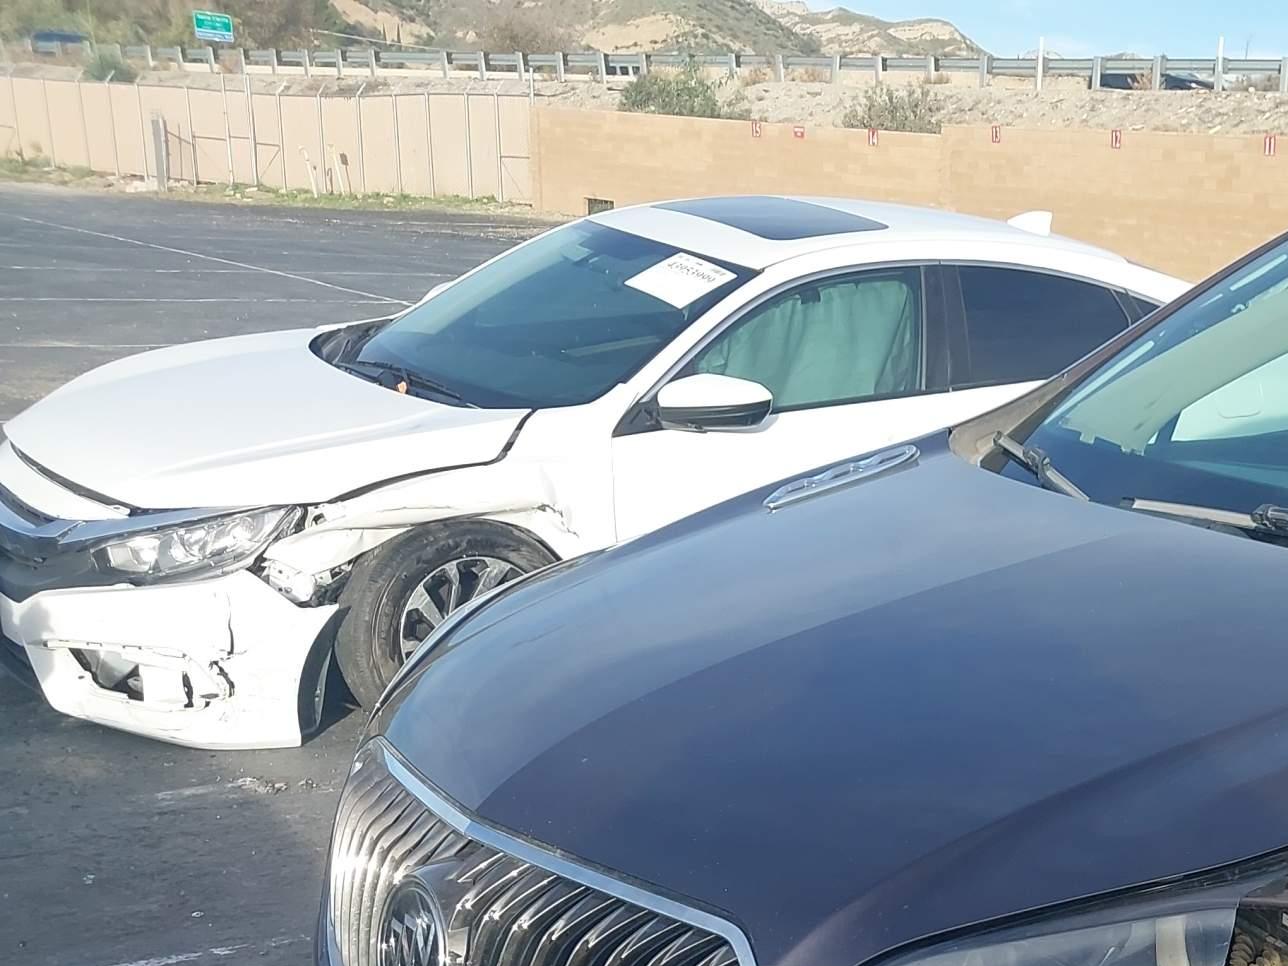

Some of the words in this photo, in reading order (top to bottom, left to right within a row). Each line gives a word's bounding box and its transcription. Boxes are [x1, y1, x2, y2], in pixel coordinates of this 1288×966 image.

[751, 121, 761, 137] 15
[868, 129, 878, 146] 14
[992, 126, 1000, 142] 13
[1112, 130, 1121, 149] 12
[1265, 135, 1275, 155] 11
